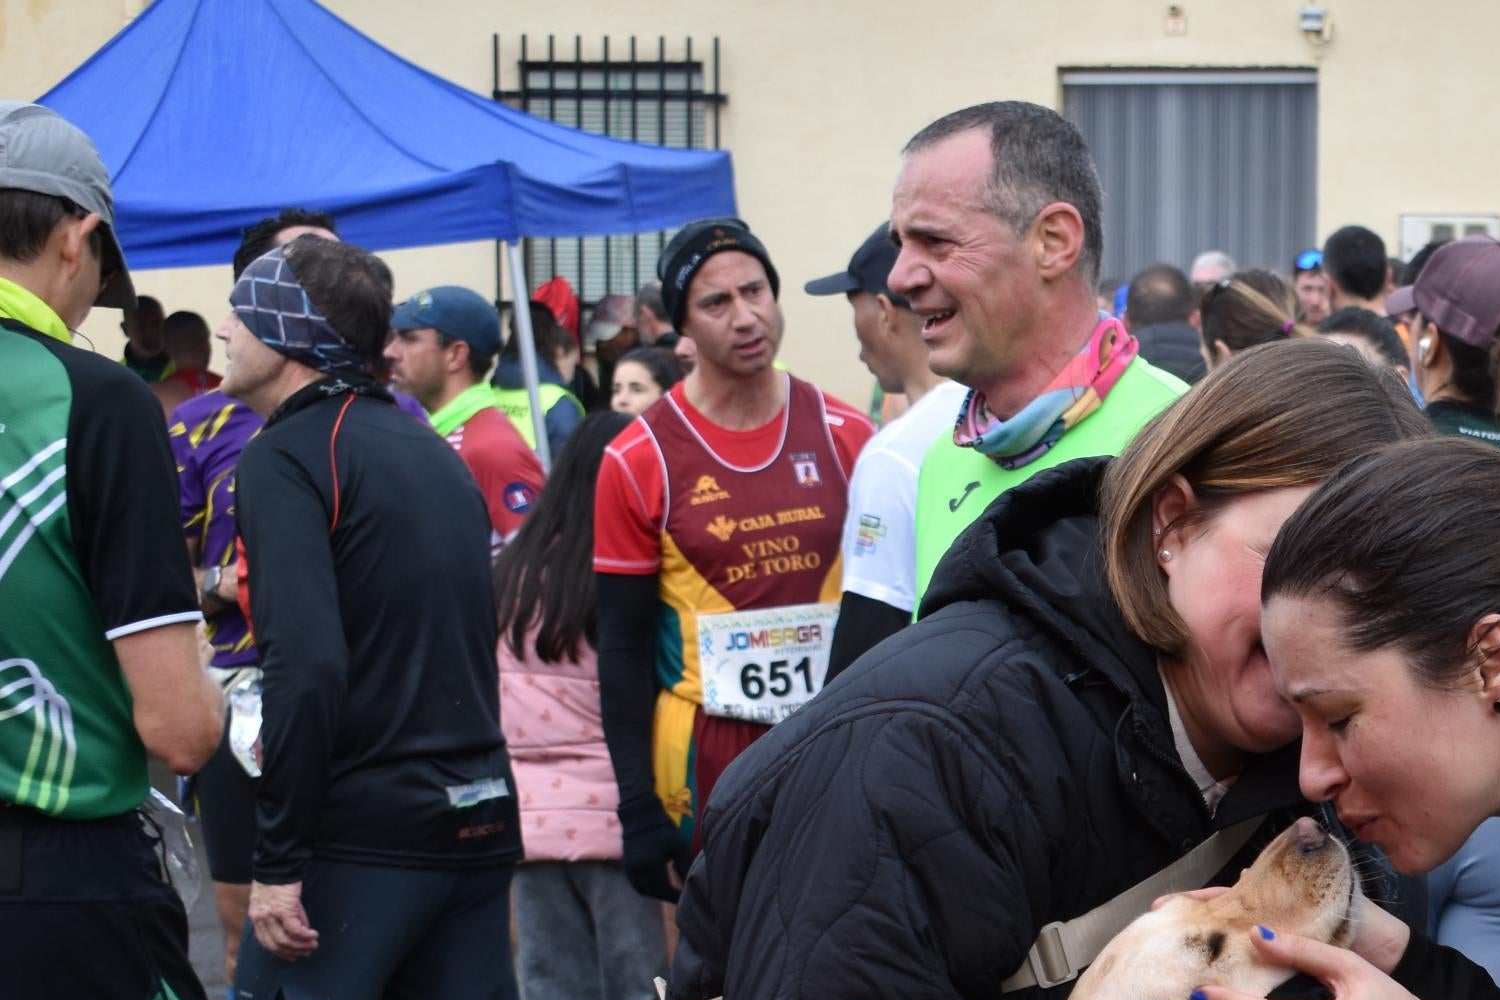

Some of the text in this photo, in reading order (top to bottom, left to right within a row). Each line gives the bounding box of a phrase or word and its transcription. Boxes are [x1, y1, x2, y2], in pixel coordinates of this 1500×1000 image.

[738, 506, 827, 532] CAJA RURAL
[742, 535, 800, 561] VINO
[727, 551, 822, 584] DE TORO
[726, 624, 822, 651] JOMISAGA
[740, 656, 815, 700] 651
